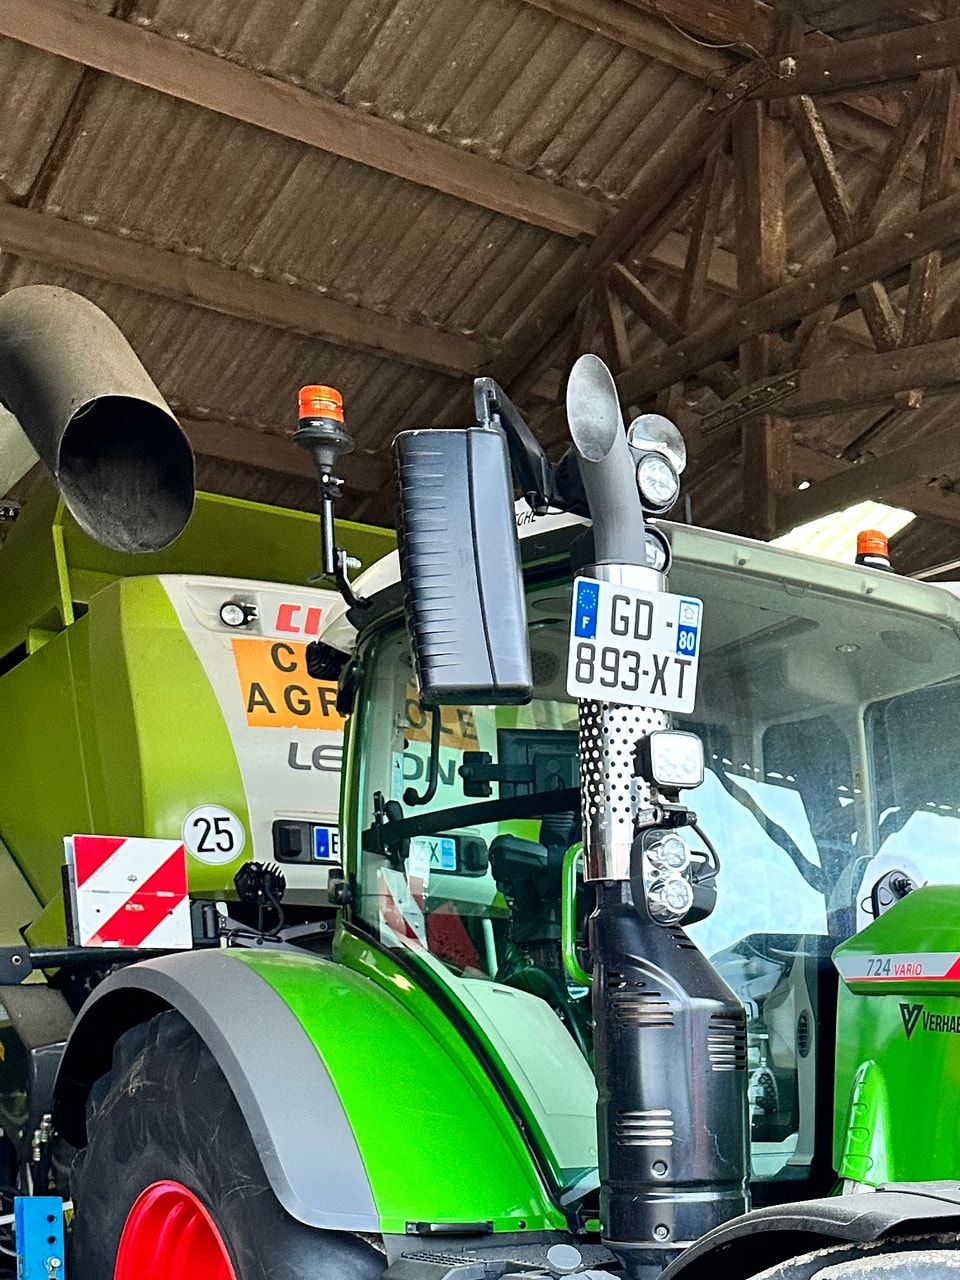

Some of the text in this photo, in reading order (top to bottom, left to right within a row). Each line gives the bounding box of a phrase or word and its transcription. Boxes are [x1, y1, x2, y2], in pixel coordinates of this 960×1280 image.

[678, 631, 695, 651] 80
[574, 641, 692, 699] 893-XT
[193, 816, 235, 853] 25
[865, 958, 923, 977] 724 VARIO
